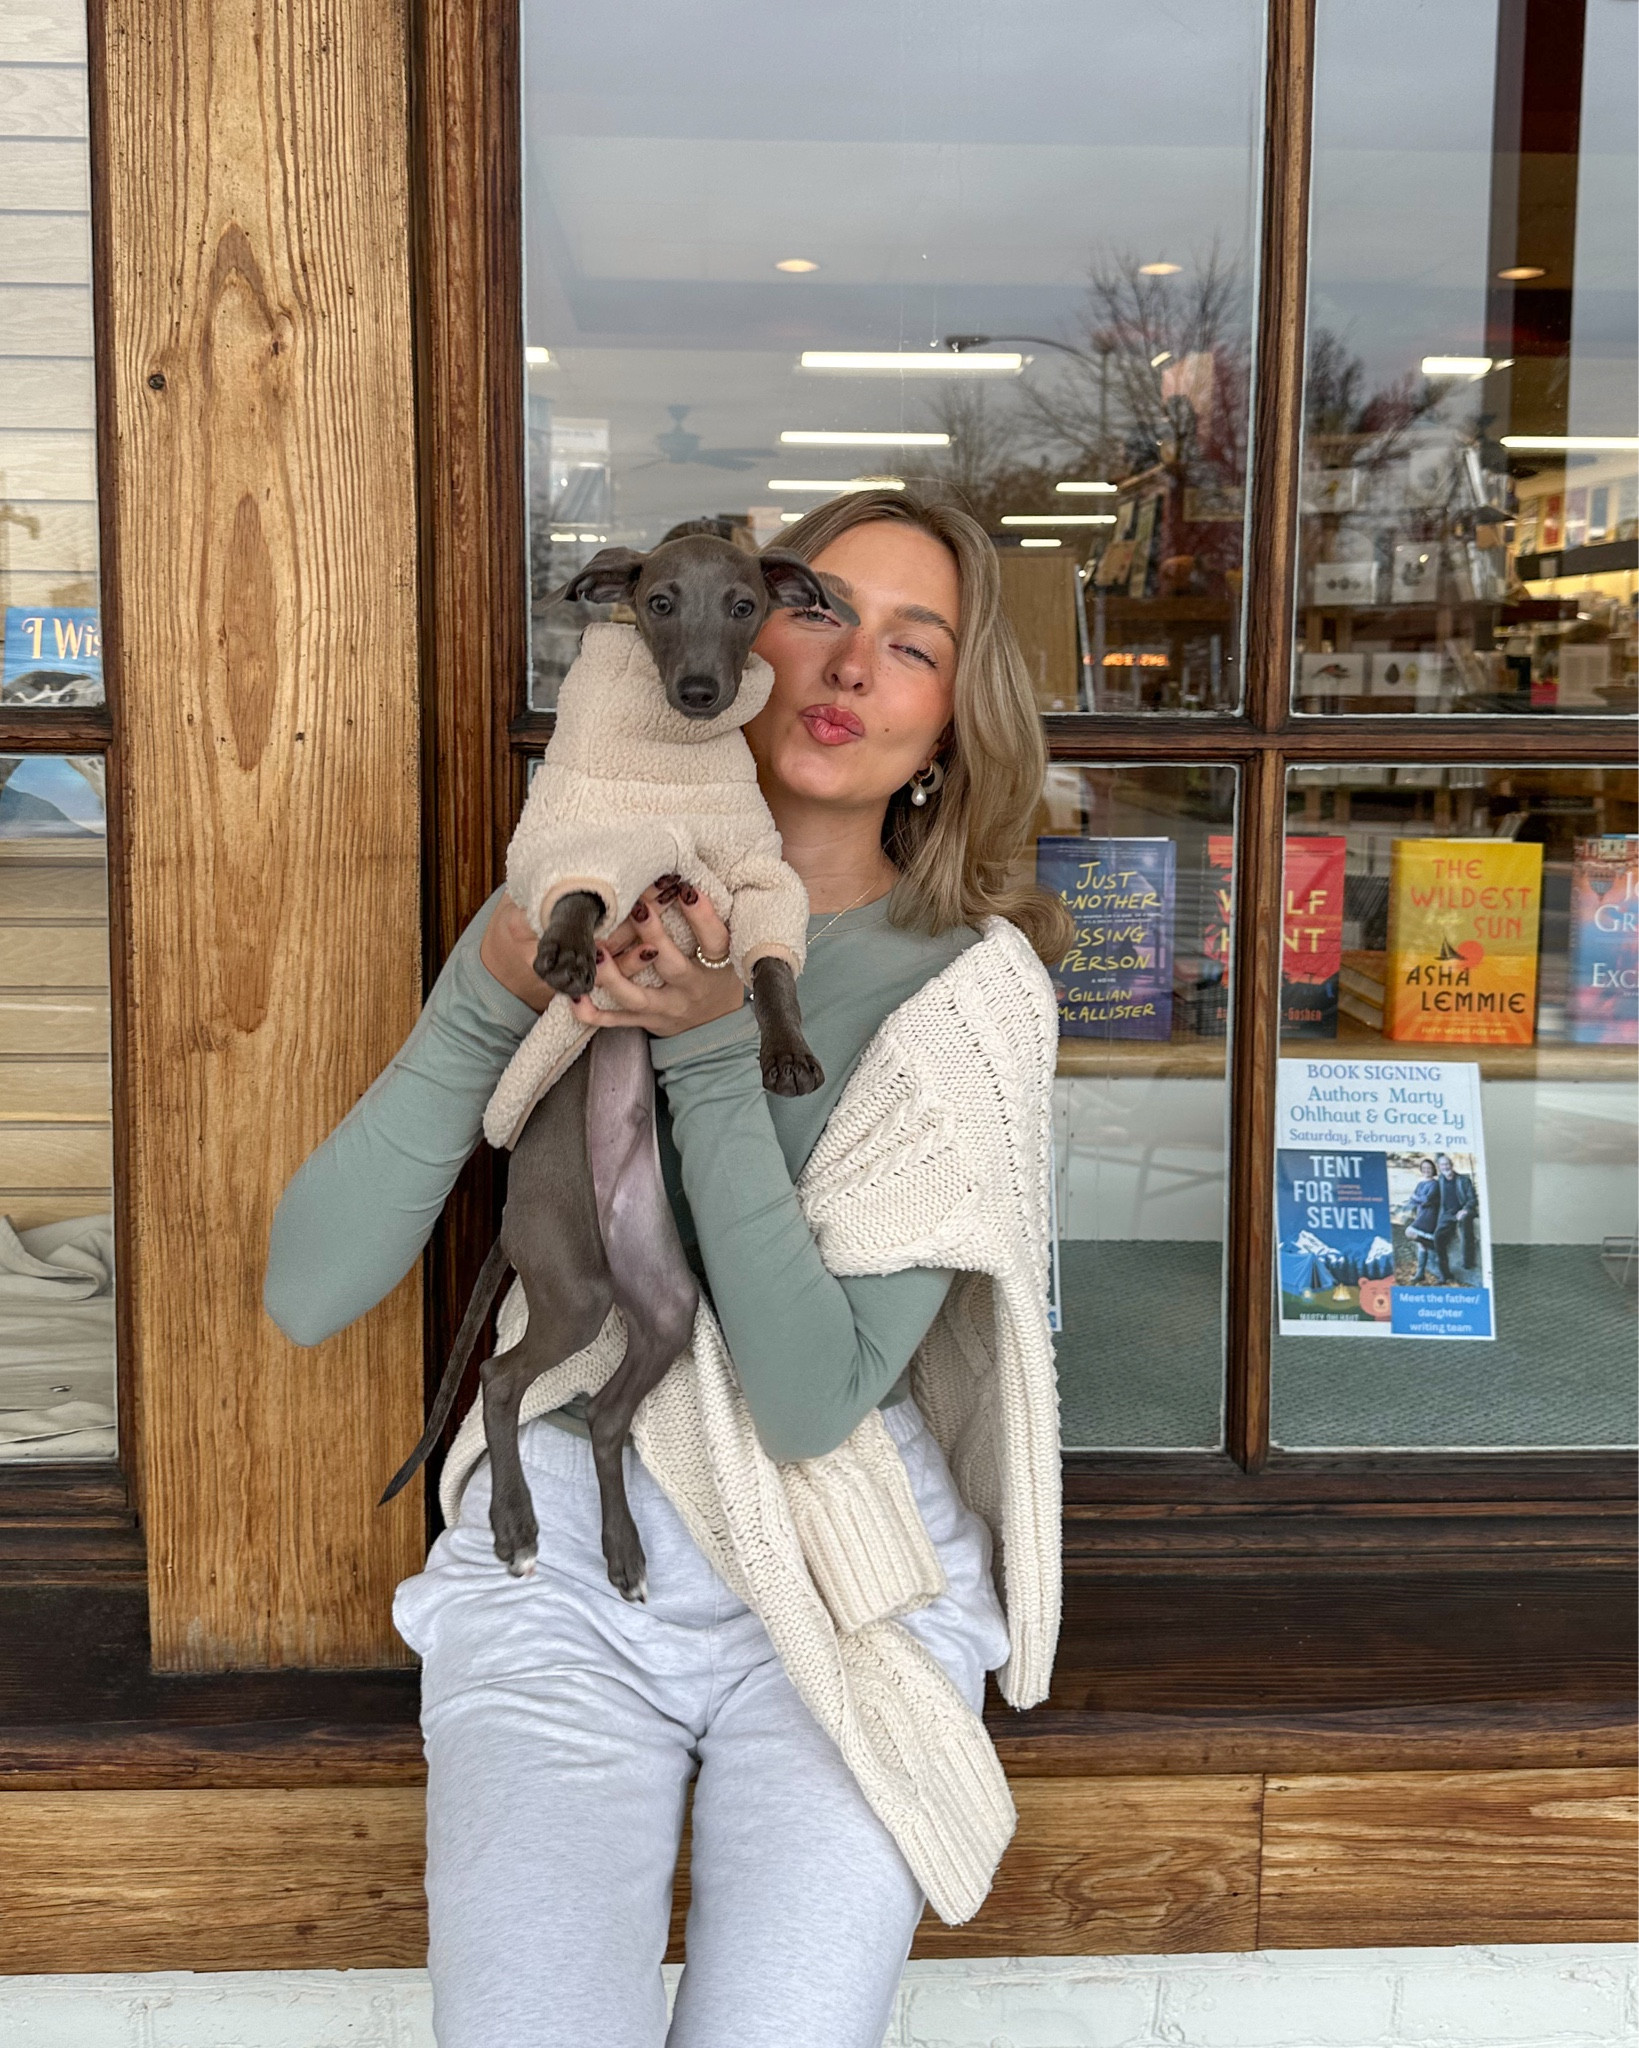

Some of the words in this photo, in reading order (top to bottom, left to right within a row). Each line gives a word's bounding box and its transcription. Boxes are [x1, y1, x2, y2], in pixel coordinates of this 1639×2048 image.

[22, 617, 46, 660] I
[1076, 861, 1138, 890] JUST
[1432, 858, 1483, 880] THE
[1410, 886, 1532, 910] WILDEST
[1074, 925, 1147, 948] ISSING
[1473, 917, 1522, 939] SUN
[1059, 949, 1152, 972] PERSON
[1406, 965, 1470, 986] ASHA
[1068, 986, 1132, 1002] GILLIAN
[1421, 990, 1526, 1014] LEMMIE
[1308, 1064, 1360, 1079] BOOK
[1364, 1065, 1440, 1081] SIGNING
[1308, 1086, 1378, 1102] Authors
[1389, 1088, 1444, 1108] Marty
[1290, 1106, 1360, 1122] Ohlhaut
[1366, 1108, 1378, 1123] &
[1384, 1108, 1437, 1124] Grace
[1442, 1110, 1464, 1130] Ly
[1290, 1128, 1351, 1145] Saturday,
[1355, 1130, 1415, 1147] February
[1418, 1132, 1430, 1146] 3,
[1434, 1133, 1442, 1144] 2
[1446, 1134, 1466, 1147] pm
[1309, 1155, 1363, 1178] TENT
[1294, 1180, 1333, 1202] FOR
[1307, 1206, 1374, 1230] SEVEN
[1400, 1293, 1425, 1302] Meet
[1427, 1294, 1443, 1303] the
[1446, 1294, 1480, 1304] father/
[1418, 1308, 1463, 1319] daughter
[1410, 1322, 1445, 1333] writing
[1446, 1324, 1472, 1332] team
